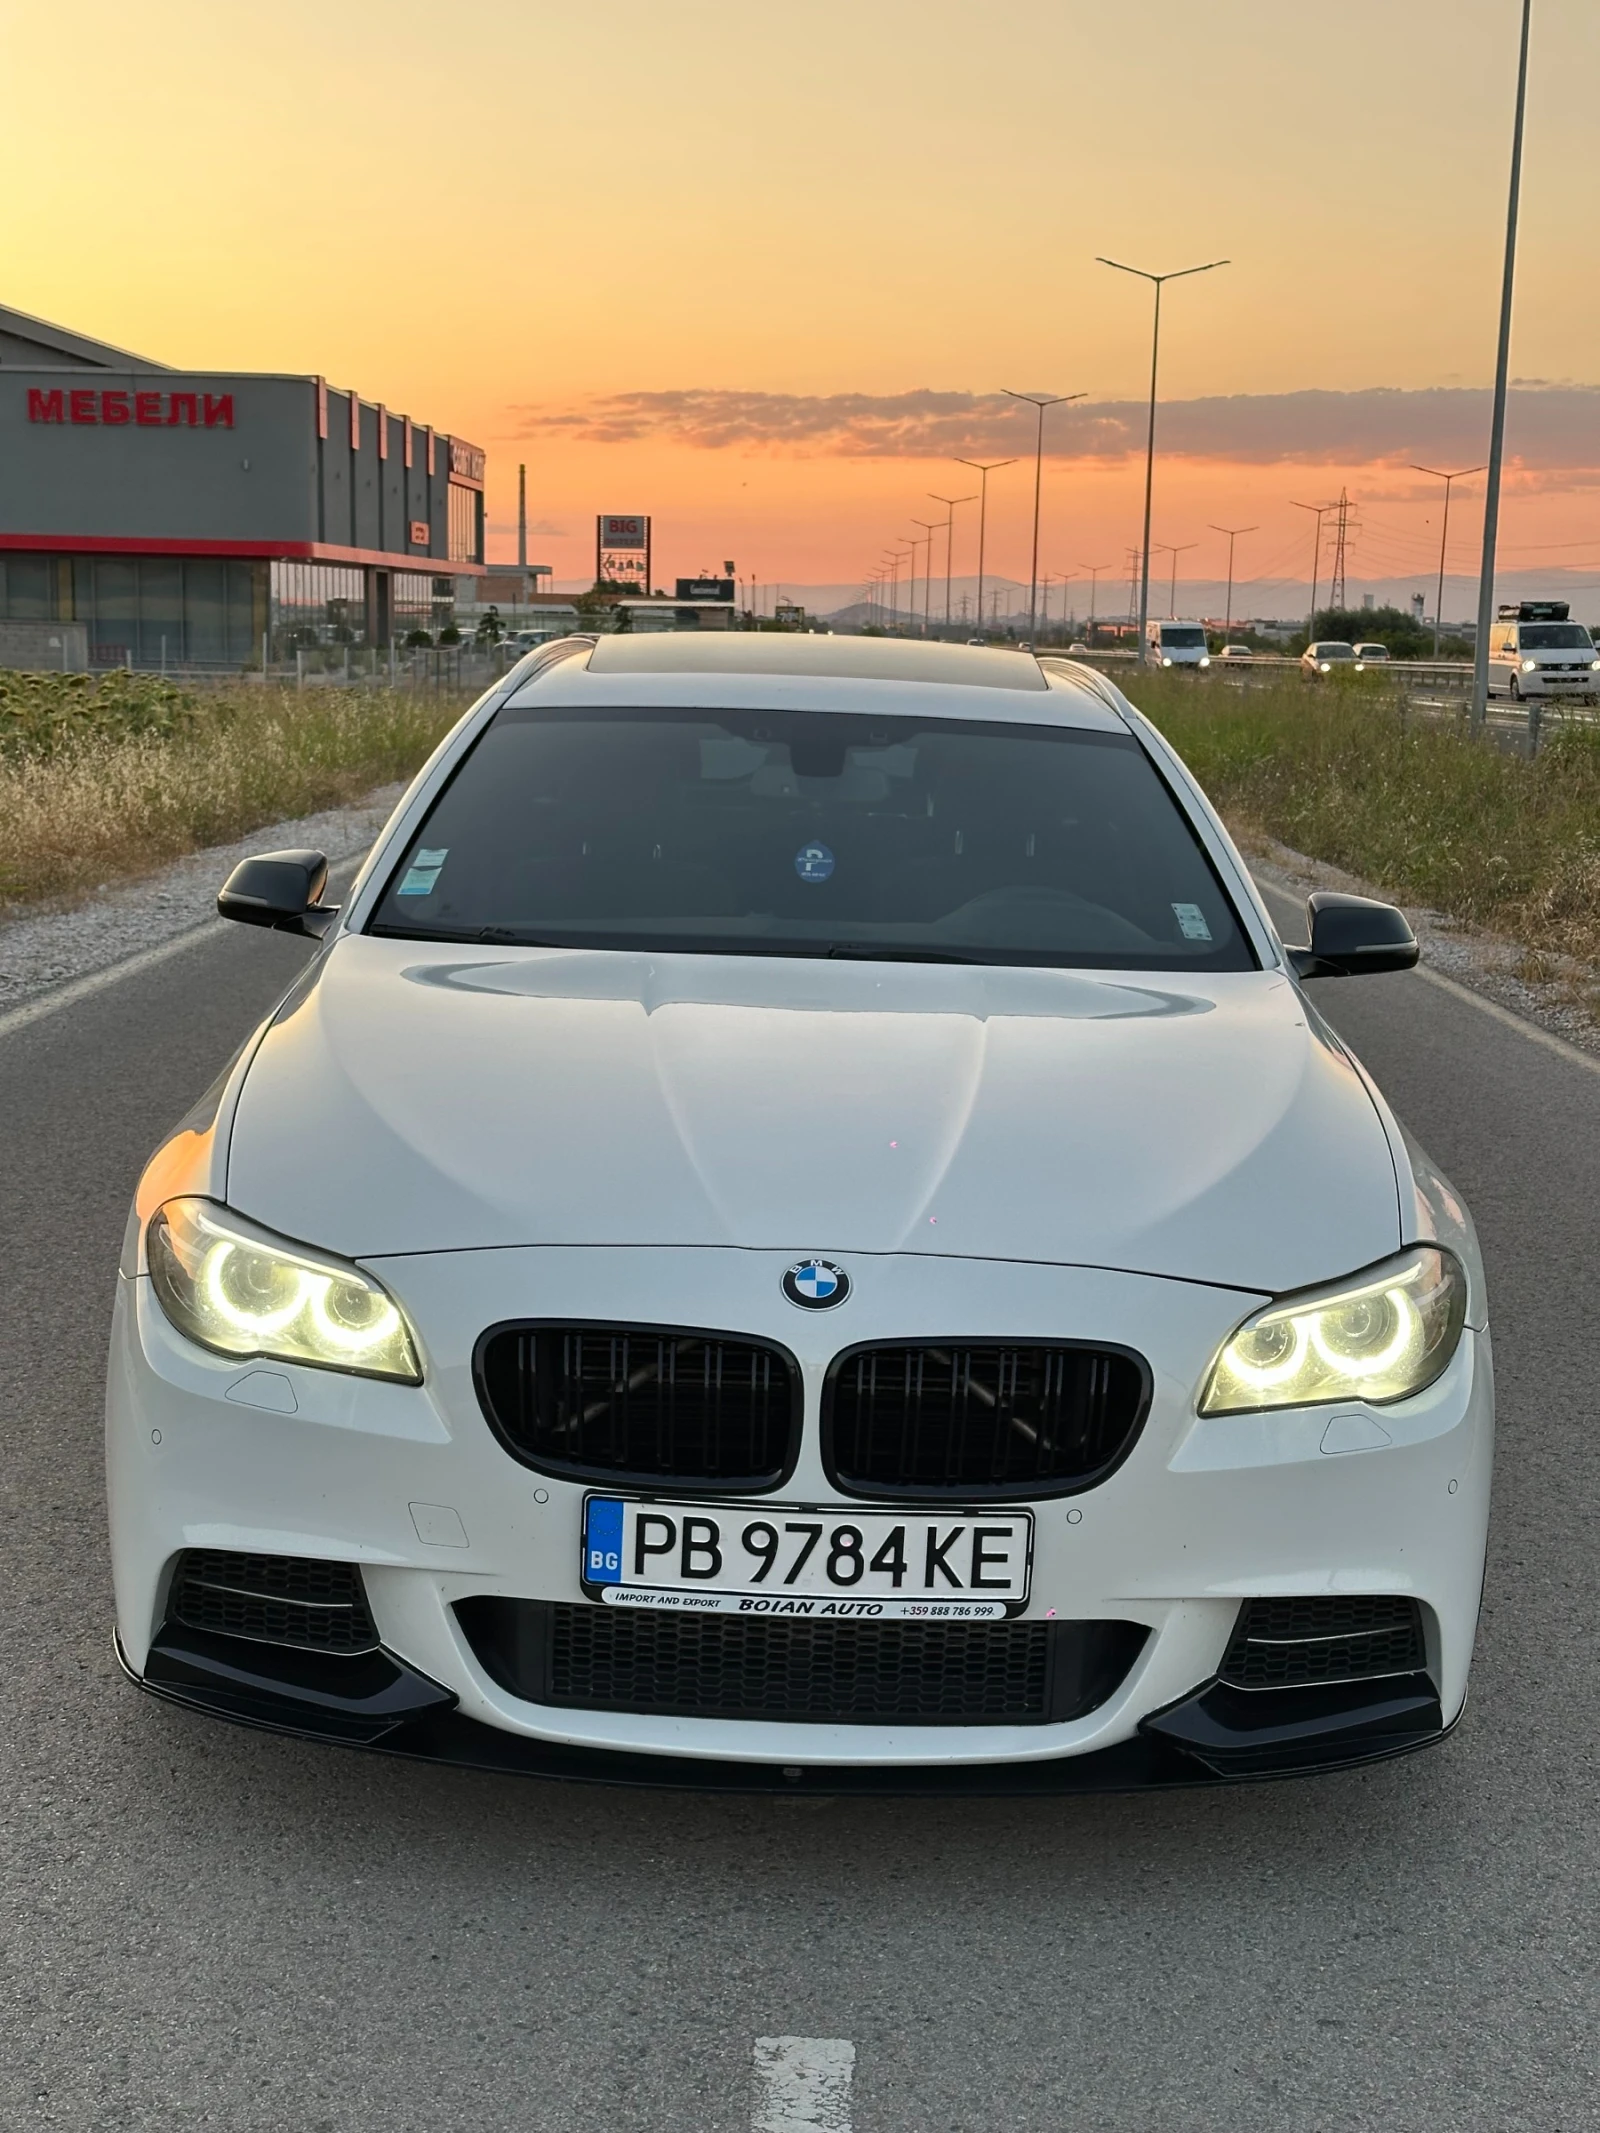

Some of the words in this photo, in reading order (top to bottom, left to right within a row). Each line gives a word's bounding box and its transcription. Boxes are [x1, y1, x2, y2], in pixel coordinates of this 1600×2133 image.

[27, 388, 234, 427] МЕБЕЛИ
[609, 520, 637, 533] BIG
[789, 1260, 844, 1276] BMW
[635, 1512, 723, 1579] PB
[741, 1520, 908, 1588] 9784
[924, 1525, 1014, 1589] KE
[591, 1550, 618, 1570] BG
[615, 1592, 656, 1604] IMPORT
[657, 1596, 680, 1605] AND
[682, 1598, 721, 1608] EXPORT
[738, 1598, 815, 1614] BOIAN
[819, 1602, 883, 1616] AUTO
[900, 1606, 929, 1616] +359
[930, 1606, 950, 1616] 888
[952, 1606, 971, 1616] 786
